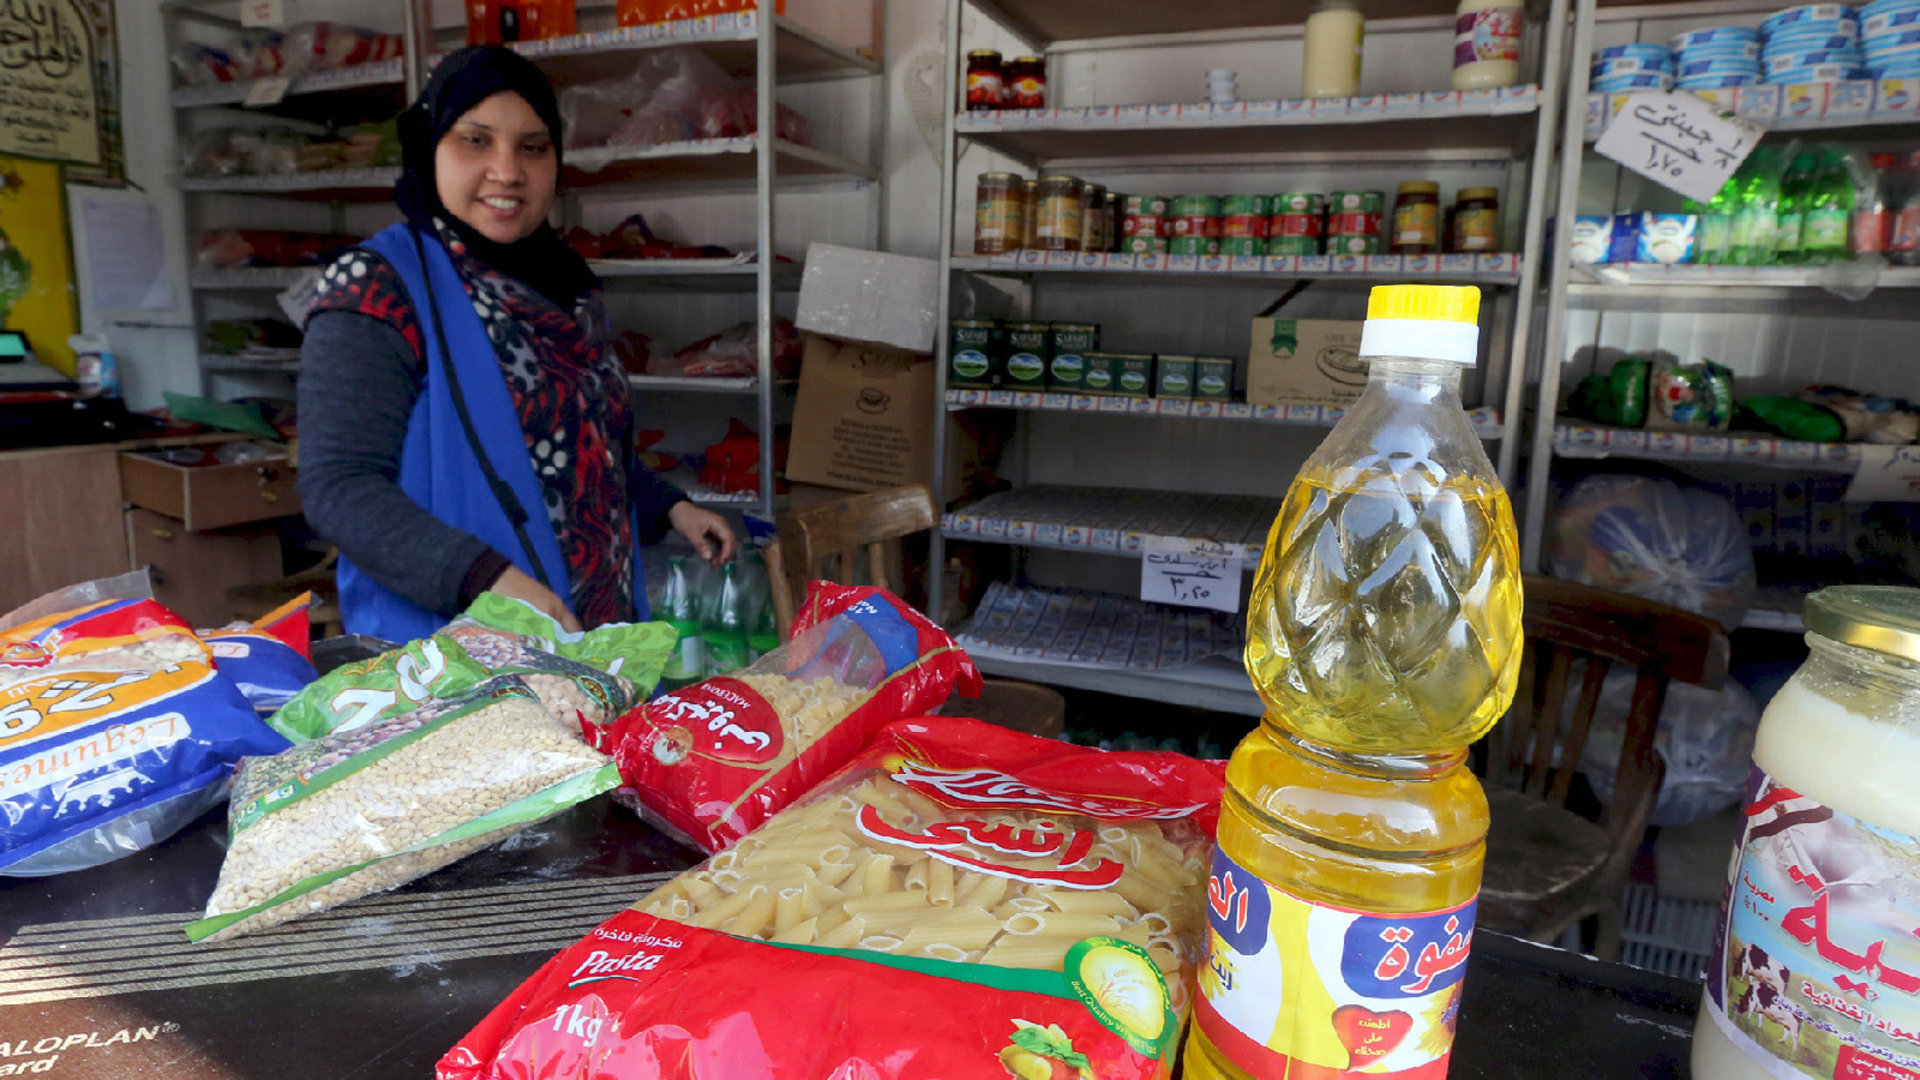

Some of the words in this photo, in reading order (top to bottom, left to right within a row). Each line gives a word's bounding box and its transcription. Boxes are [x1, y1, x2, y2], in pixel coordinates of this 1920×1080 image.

[571, 950, 665, 978] Pasta
[1071, 979, 1088, 998] Best
[1085, 995, 1115, 1026] Quality
